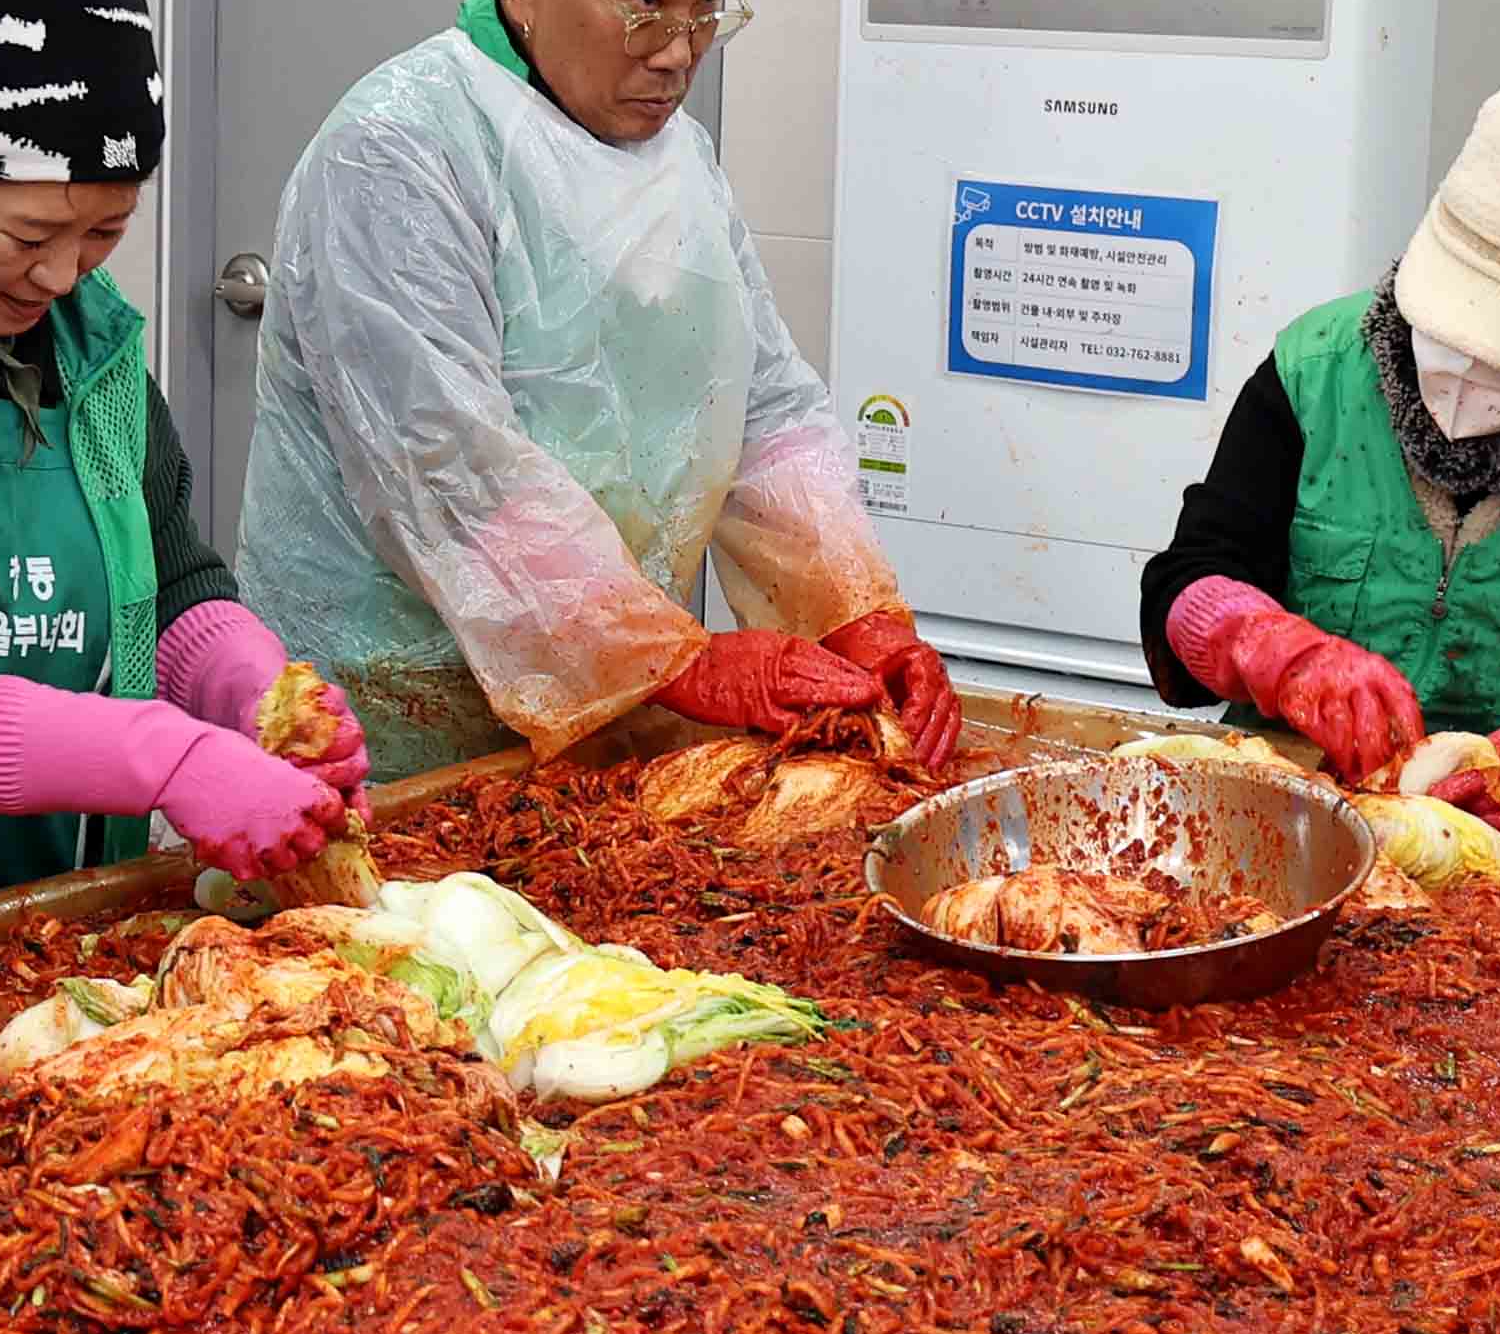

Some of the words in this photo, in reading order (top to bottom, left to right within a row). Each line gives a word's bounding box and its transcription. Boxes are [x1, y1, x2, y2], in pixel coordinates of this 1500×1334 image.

[1044, 98, 1118, 116] SAMSUNG
[1015, 200, 1064, 222] CCTV
[1069, 203, 1143, 231] 설치안내
[1105, 249, 1168, 267] 시설안전관리
[974, 267, 1012, 283] 촬영시간
[1022, 271, 1055, 287] 24시간
[971, 330, 999, 344] 책임자
[1020, 335, 1068, 351] 시설관리자
